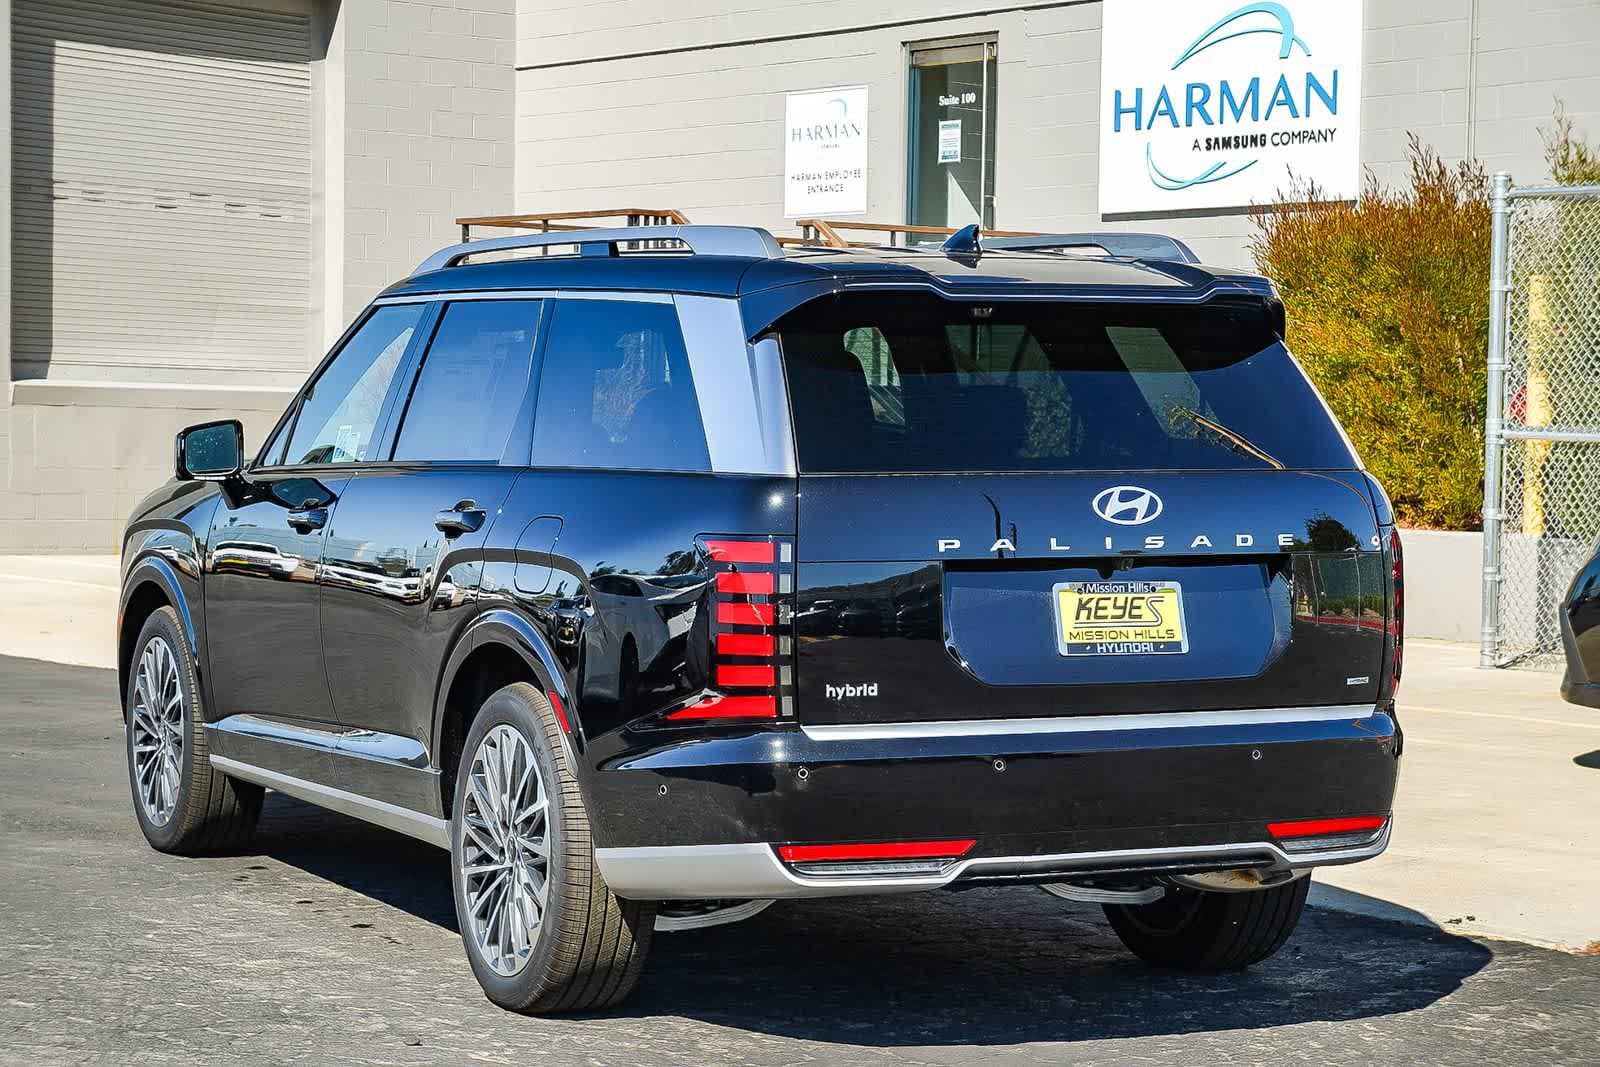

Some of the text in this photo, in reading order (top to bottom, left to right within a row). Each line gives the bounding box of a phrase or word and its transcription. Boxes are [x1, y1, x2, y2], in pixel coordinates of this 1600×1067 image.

[938, 92, 976, 106] Suite 100
[1114, 69, 1338, 132] HARMAN
[792, 123, 860, 142] HARMAN
[1192, 128, 1337, 151] A SAMSUNG COMPANY
[791, 168, 861, 181] HARMAN EMPLOYEE
[807, 183, 844, 195] ENTRANCE
[938, 533, 1295, 552] PALISADE
[1086, 582, 1151, 593] Mission Hills
[1073, 596, 1164, 628] KEYES
[1069, 629, 1175, 641] MISSION HILLS
[1097, 642, 1154, 653] HYUNDAI
[825, 682, 878, 700] hybrid
